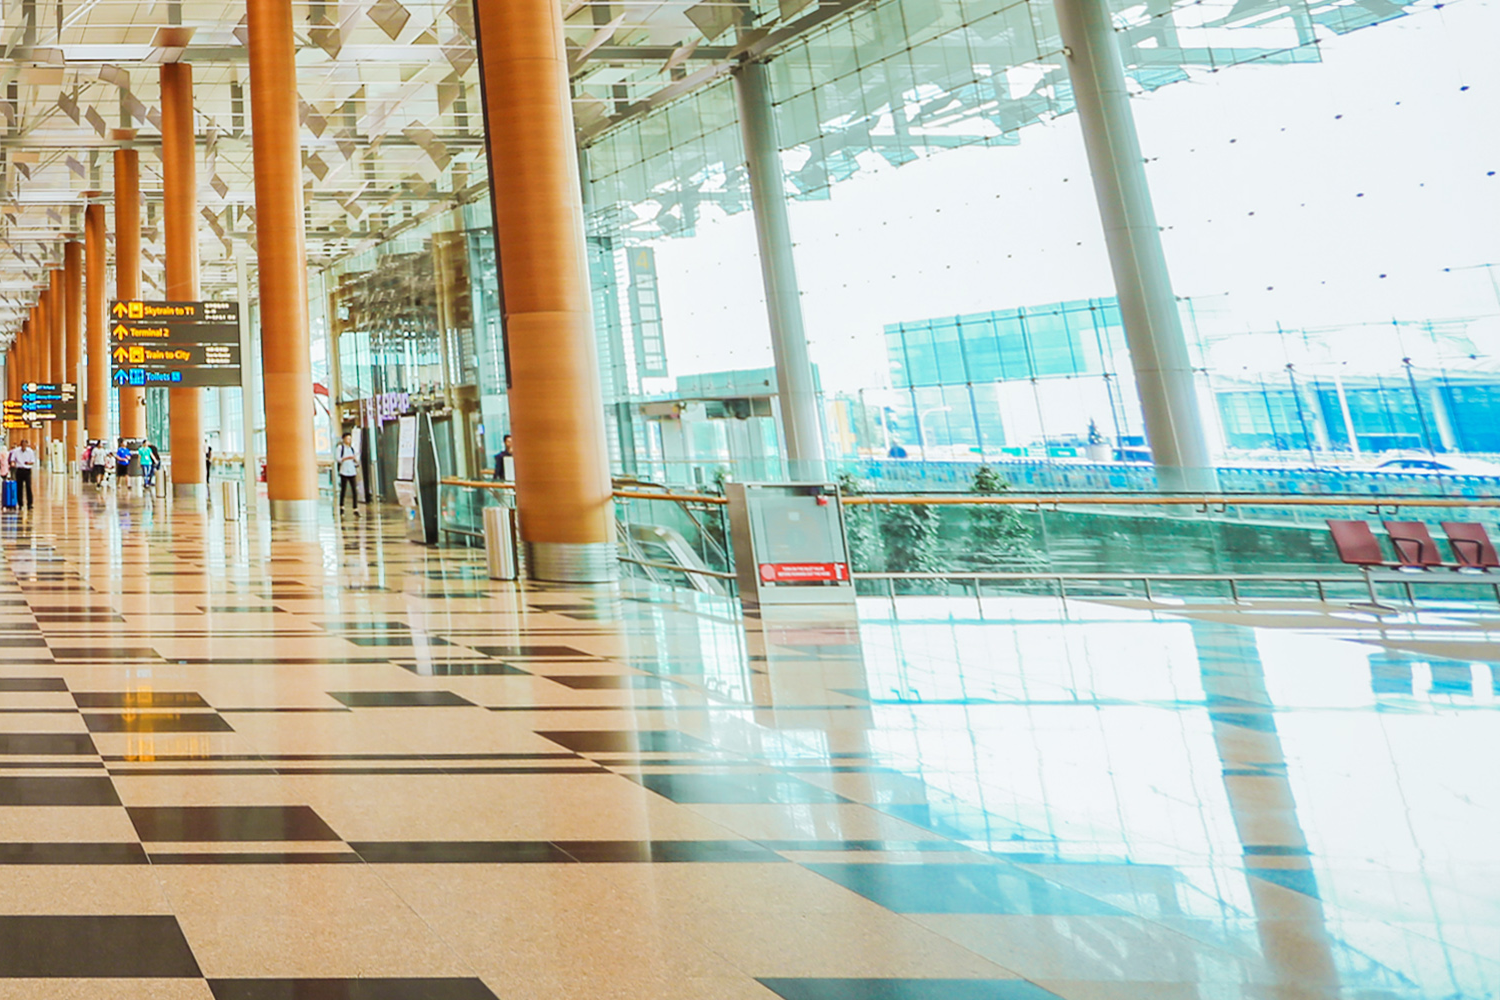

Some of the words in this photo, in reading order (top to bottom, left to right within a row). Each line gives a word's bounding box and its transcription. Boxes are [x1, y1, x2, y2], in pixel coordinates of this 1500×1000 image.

[144, 305, 174, 317] Skytrain
[175, 306, 184, 316] to
[184, 306, 195, 316] T1
[129, 327, 163, 338] Terminal
[163, 327, 170, 338] 2
[145, 350, 165, 359] Train
[165, 351, 174, 359] to
[174, 350, 191, 362] City
[146, 372, 170, 381] Toilets
